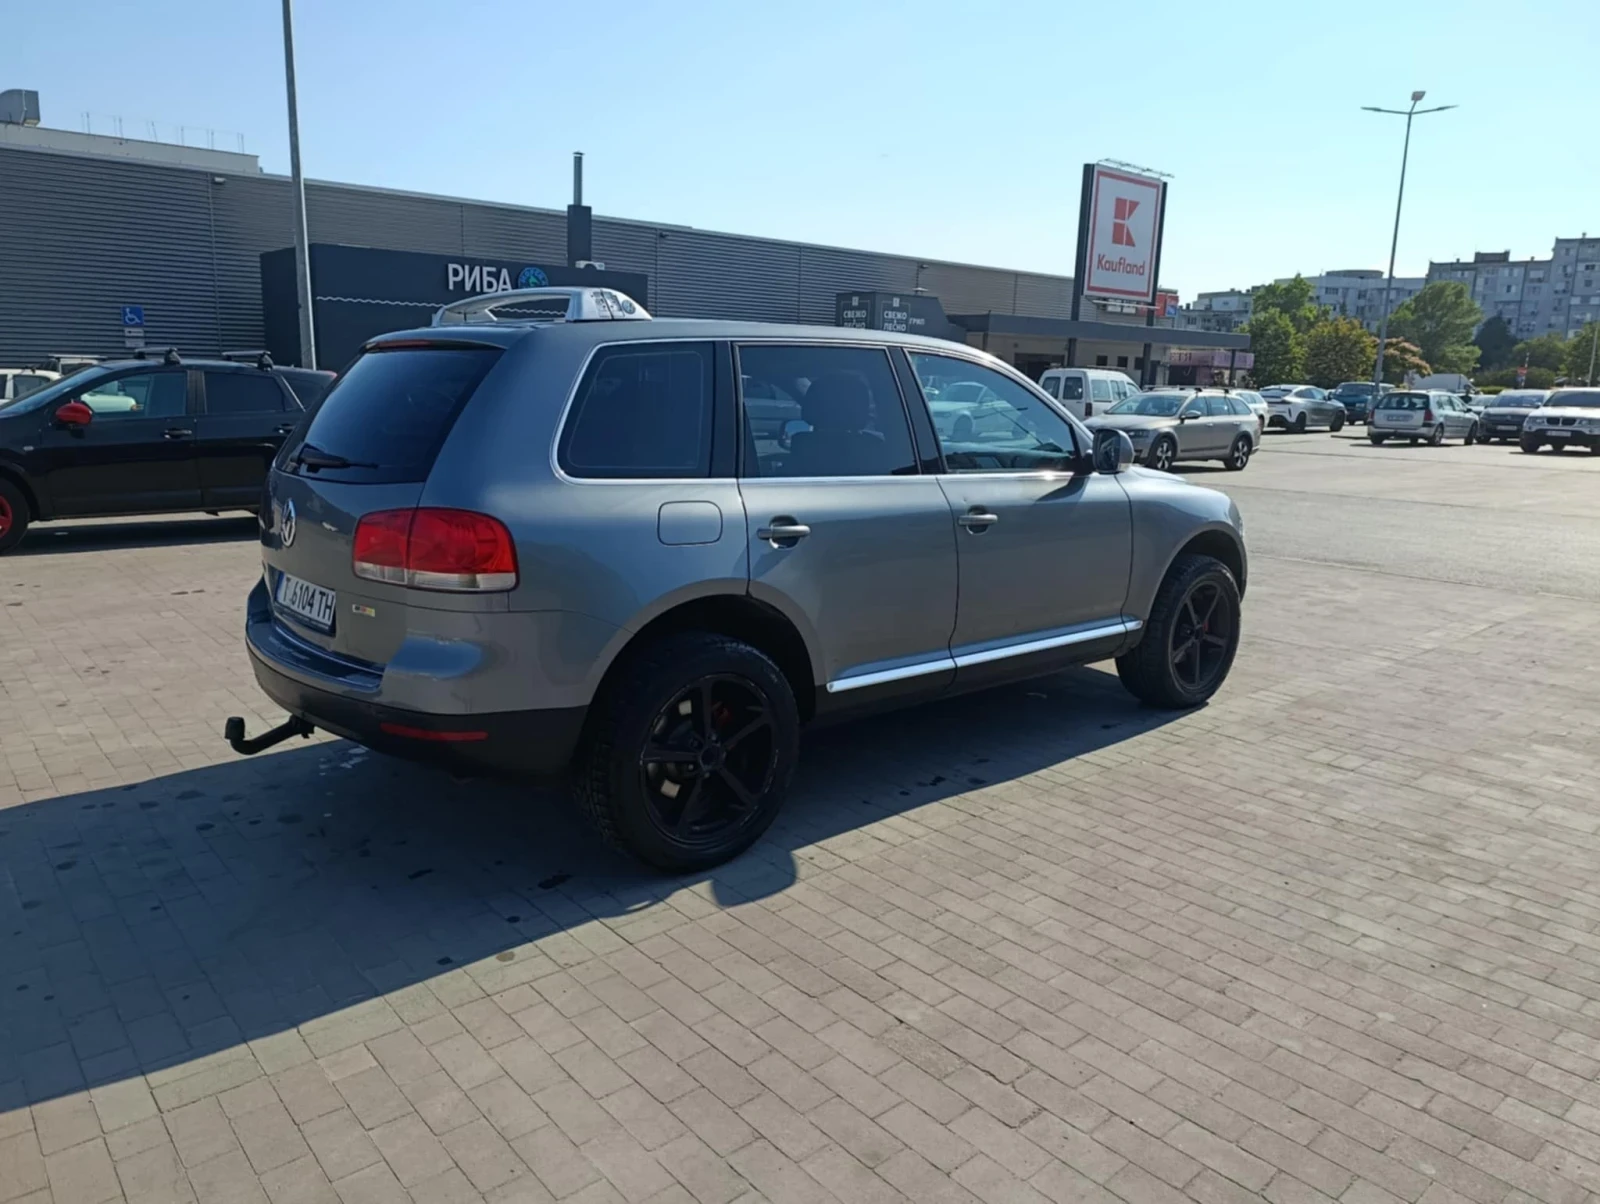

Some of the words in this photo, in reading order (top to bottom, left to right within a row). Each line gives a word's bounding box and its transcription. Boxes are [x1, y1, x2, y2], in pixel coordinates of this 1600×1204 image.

[1097, 254, 1146, 276] Kaufland
[447, 263, 513, 293] РИБА
[843, 310, 866, 318] СВЕЖО
[884, 311, 907, 320] СВЕЖО
[291, 581, 316, 614] 6104
[317, 591, 335, 622] TH
